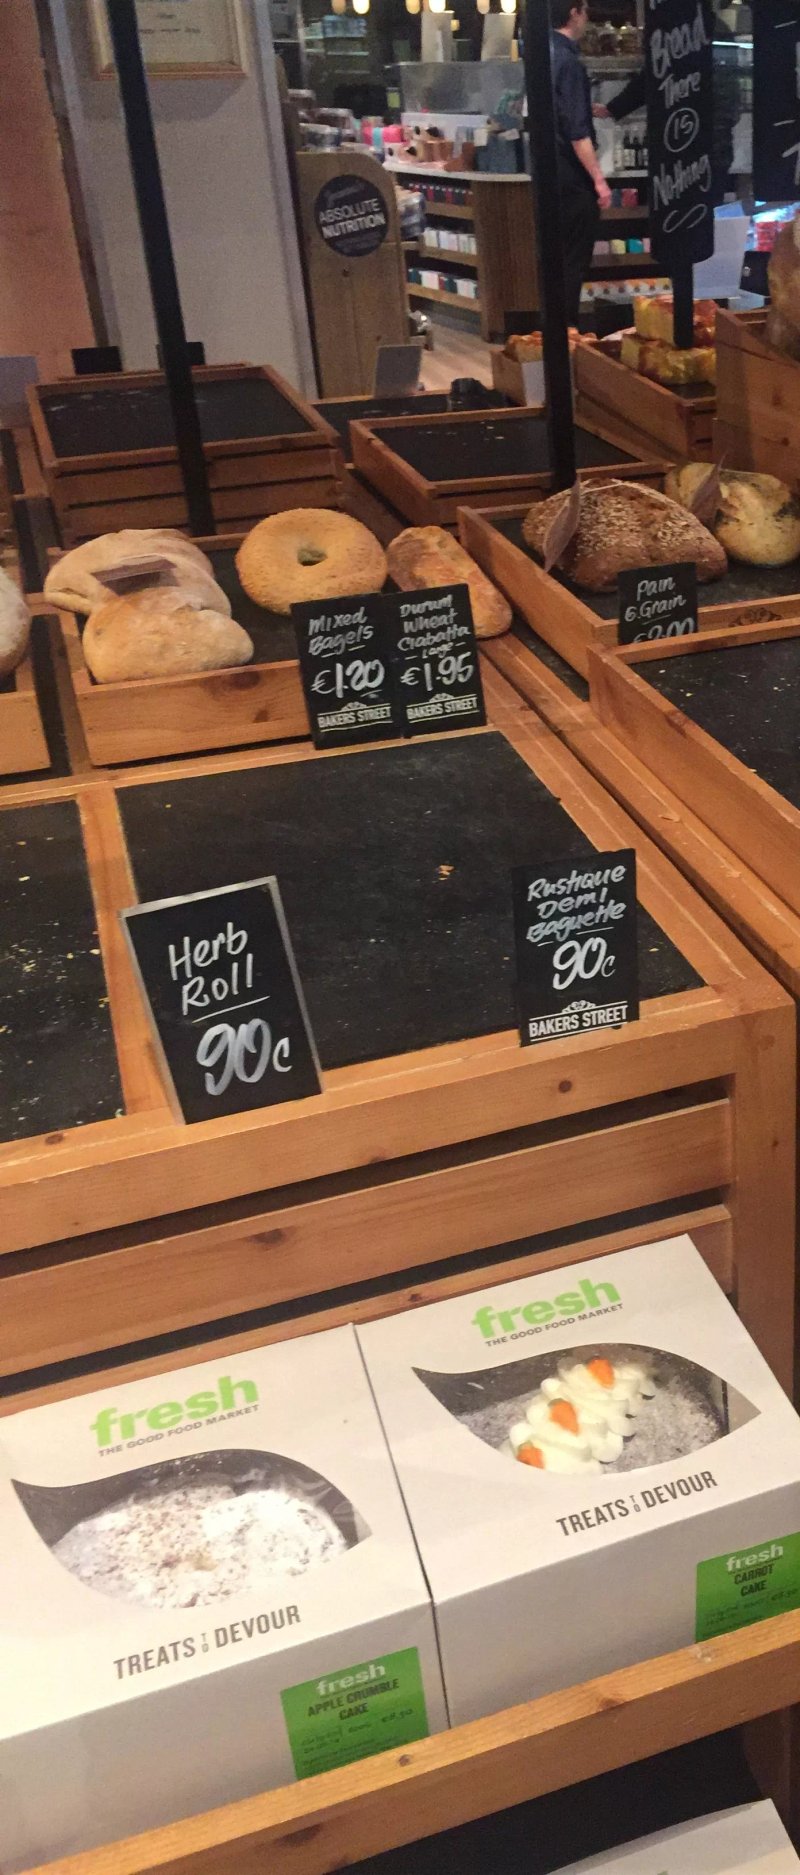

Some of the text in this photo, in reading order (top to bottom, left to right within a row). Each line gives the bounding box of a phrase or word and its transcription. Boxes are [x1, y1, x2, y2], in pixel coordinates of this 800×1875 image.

[650, 2, 710, 79] Bread
[658, 72, 701, 109] There
[652, 154, 712, 211] Nothing
[318, 198, 381, 223] ABSOLUTE
[321, 211, 386, 239] NUTRITION
[399, 594, 453, 617] Durum
[637, 577, 676, 601] Pain
[308, 606, 367, 636] Mixed
[397, 626, 471, 651] Ciabatta
[404, 608, 458, 633] Wheat
[308, 625, 374, 655] Bagels
[422, 641, 453, 659] Large
[311, 659, 385, 699] €1.20
[400, 652, 474, 692] €1.95
[317, 705, 392, 728] BAKERS STREET
[406, 696, 478, 720] BAKERS STREET
[527, 865, 627, 901] Rustique
[526, 899, 627, 942] Baguette
[168, 921, 248, 981] Herb
[552, 937, 616, 990] 90c
[182, 953, 254, 1016] Roll
[528, 1004, 629, 1038] BAKERS STREET
[196, 1018, 293, 1096] 90c
[471, 1278, 621, 1339] fresh
[485, 1302, 624, 1347] THE GOOD FOOD MARKET
[89, 1375, 259, 1447] fresh
[98, 1404, 260, 1457] THE GOOD FOOD MARKET
[556, 1498, 630, 1537] TREATS
[641, 1470, 719, 1509] DEVOUR
[726, 1543, 784, 1572] fresh
[734, 1563, 774, 1585] CARROT
[740, 1580, 767, 1597] CAKE
[113, 1637, 196, 1680] TREATS
[214, 1604, 302, 1649] DEVOUR
[308, 1696, 344, 1717] APPLE
[346, 1678, 400, 1704] CRUMBLE
[316, 1663, 386, 1696] fresh
[339, 1702, 369, 1721] CAKE
